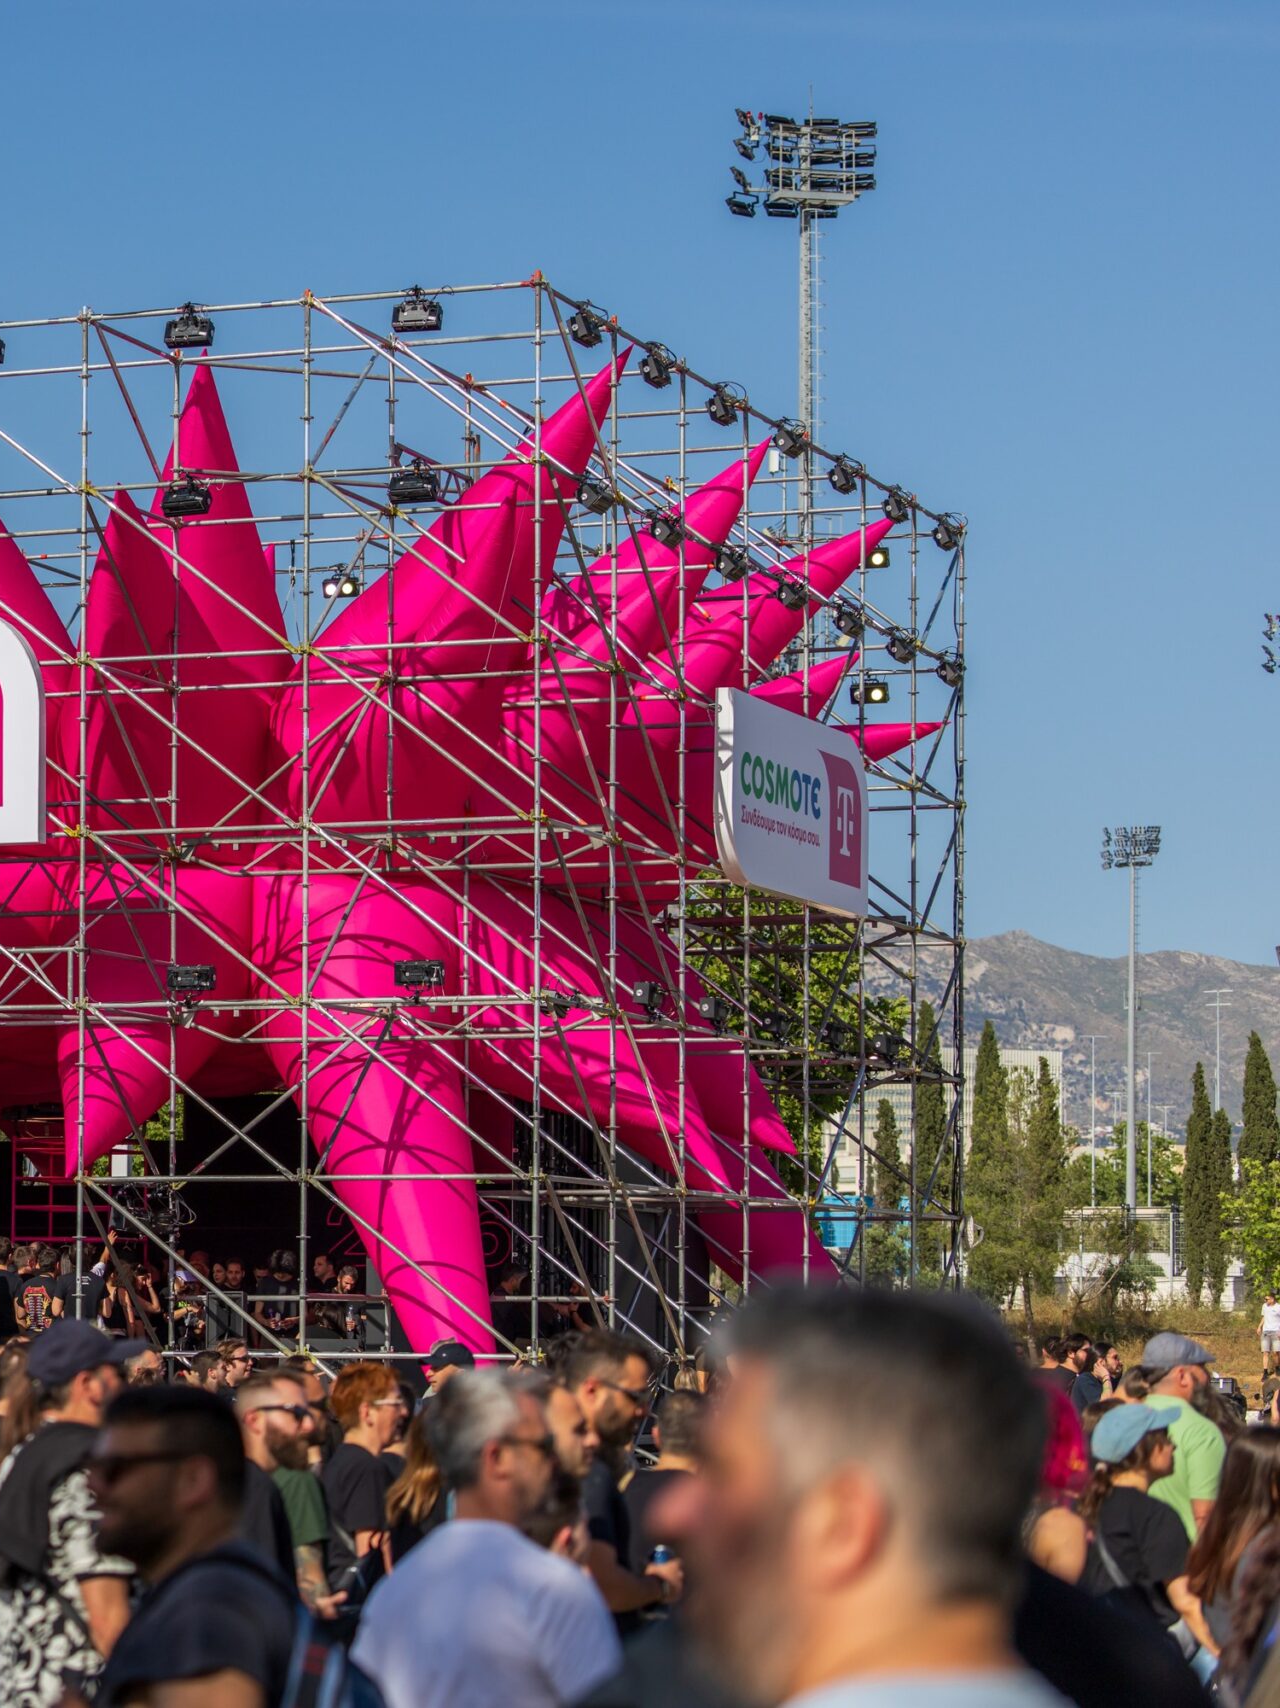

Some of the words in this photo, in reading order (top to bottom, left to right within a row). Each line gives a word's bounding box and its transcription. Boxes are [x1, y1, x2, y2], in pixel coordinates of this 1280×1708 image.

[740, 751, 821, 820] COSMOTE
[741, 805, 775, 835] Συνδέουμε
[776, 821, 787, 836] τον
[788, 823, 807, 846] κόσμο
[807, 832, 820, 847] σου.
